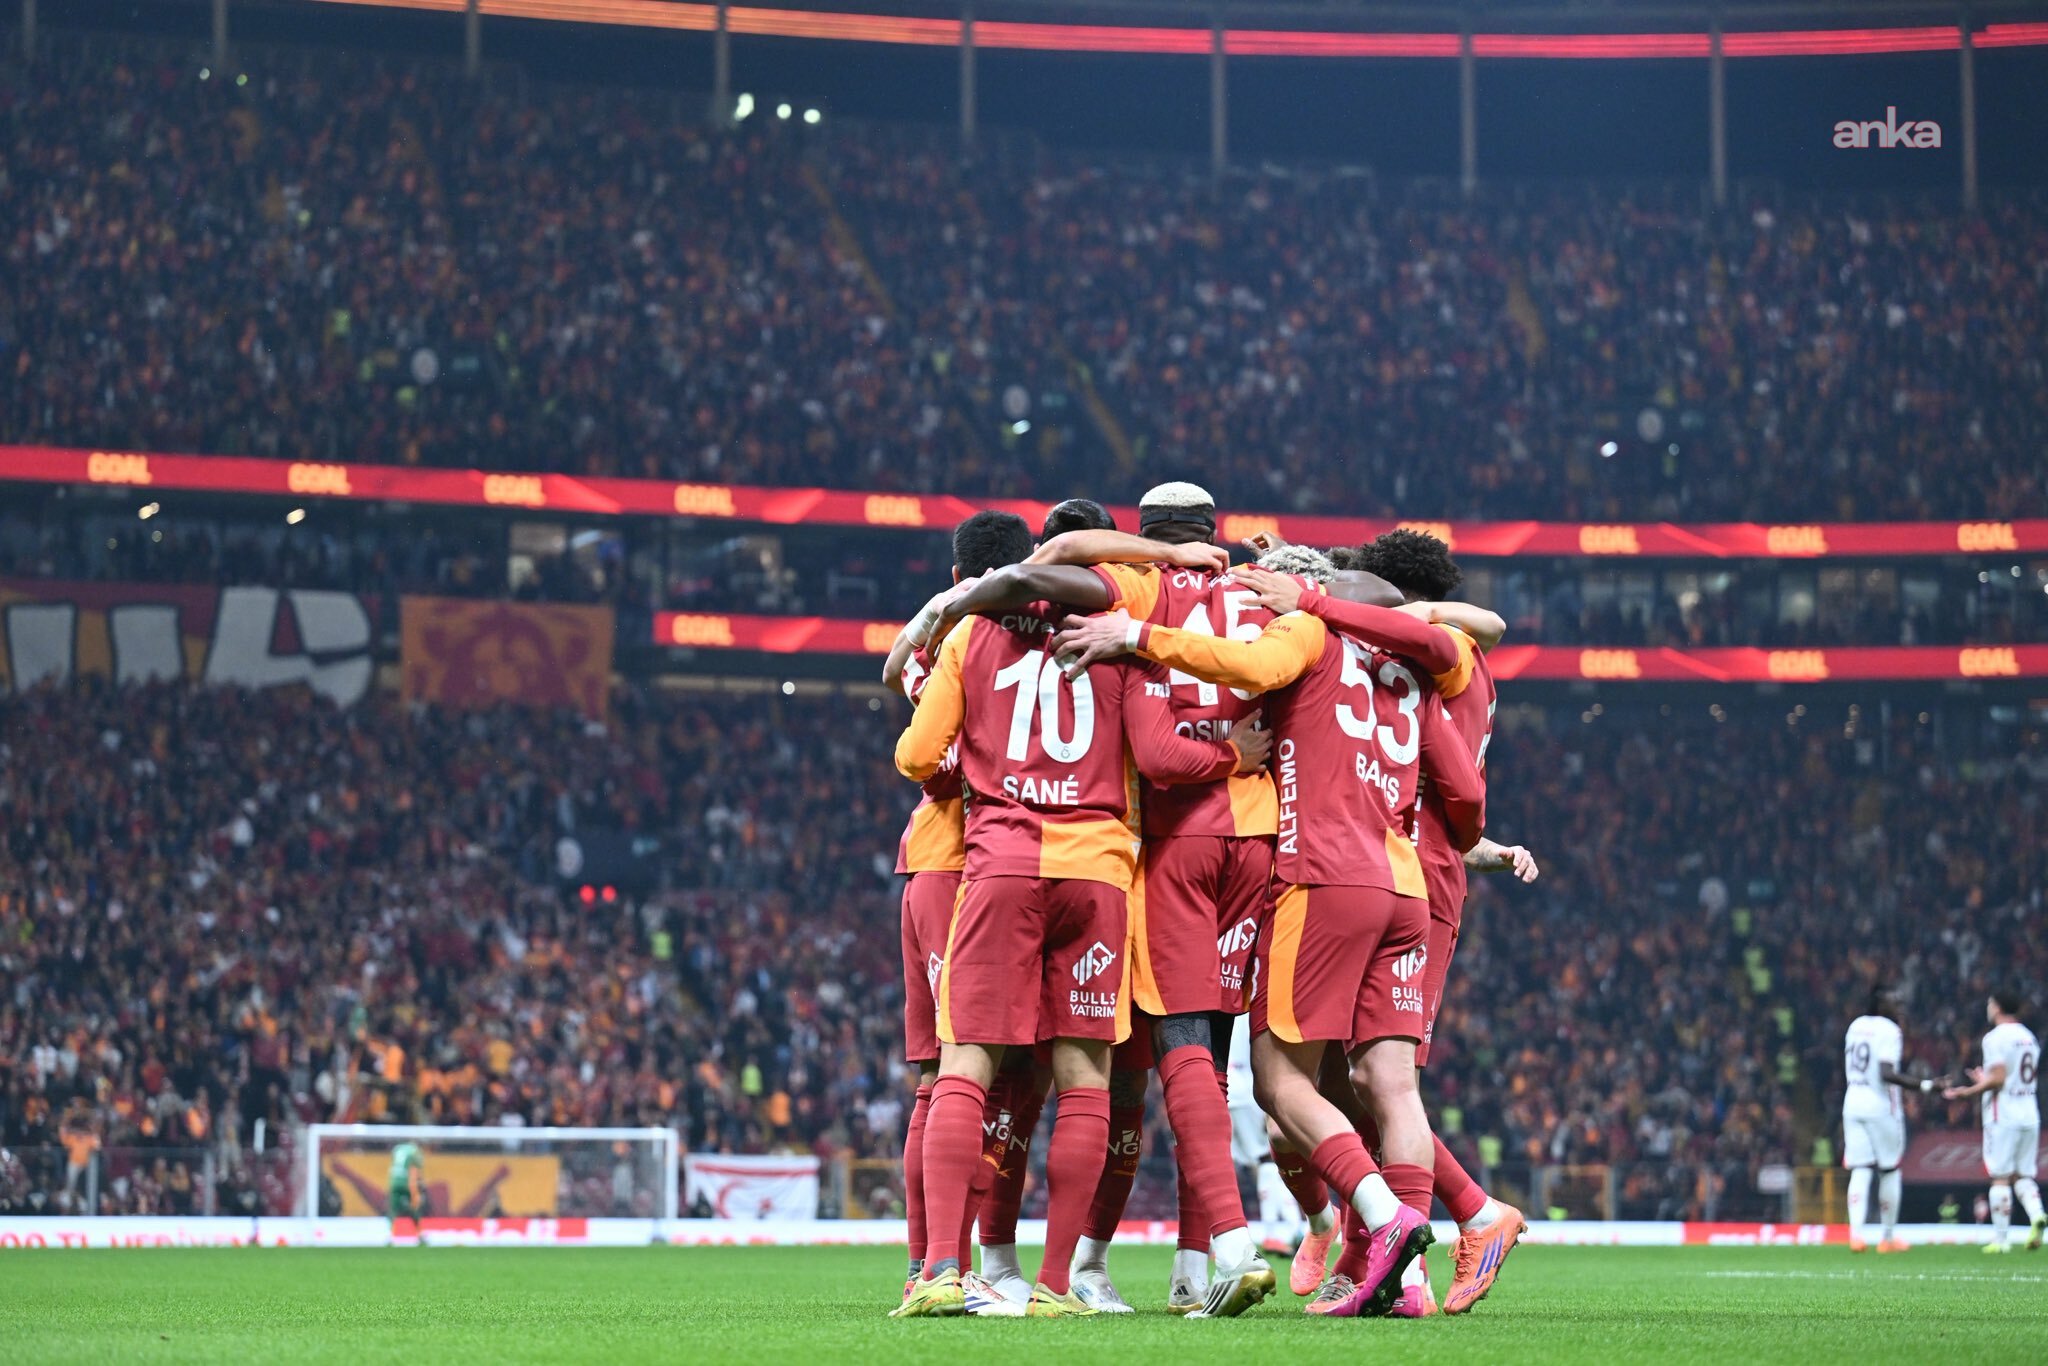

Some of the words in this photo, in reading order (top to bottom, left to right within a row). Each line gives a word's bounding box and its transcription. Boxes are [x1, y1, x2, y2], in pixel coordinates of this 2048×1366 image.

[993, 649, 1095, 763] 10
[1336, 636, 1421, 766] 53
[1003, 774, 1079, 805] SANÉ
[1278, 738, 1298, 854] ALFEMO
[1069, 990, 1116, 1005] BULLS
[1069, 1003, 1116, 1018] YATIRIM
[2019, 1051, 2035, 1085] 6
